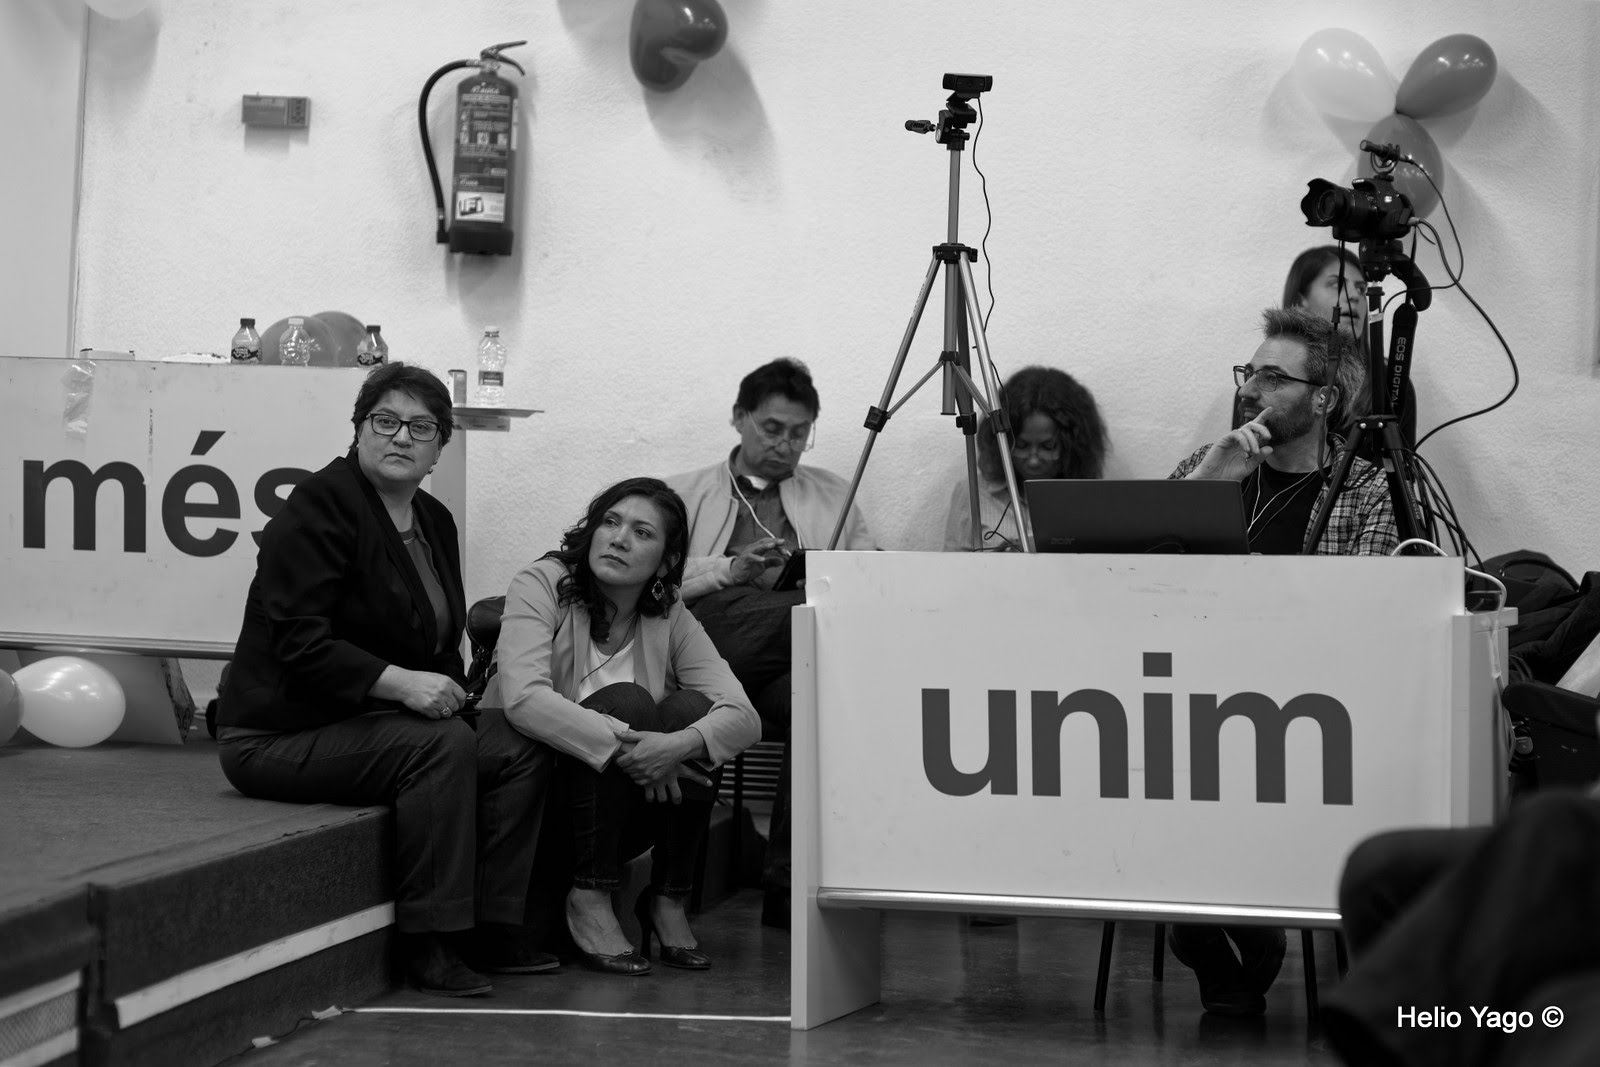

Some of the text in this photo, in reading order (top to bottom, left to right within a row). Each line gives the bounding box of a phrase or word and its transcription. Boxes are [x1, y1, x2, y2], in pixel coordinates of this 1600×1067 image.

[1390, 336, 1407, 408] EOS DIGITAL
[922, 652, 1353, 805] unim
